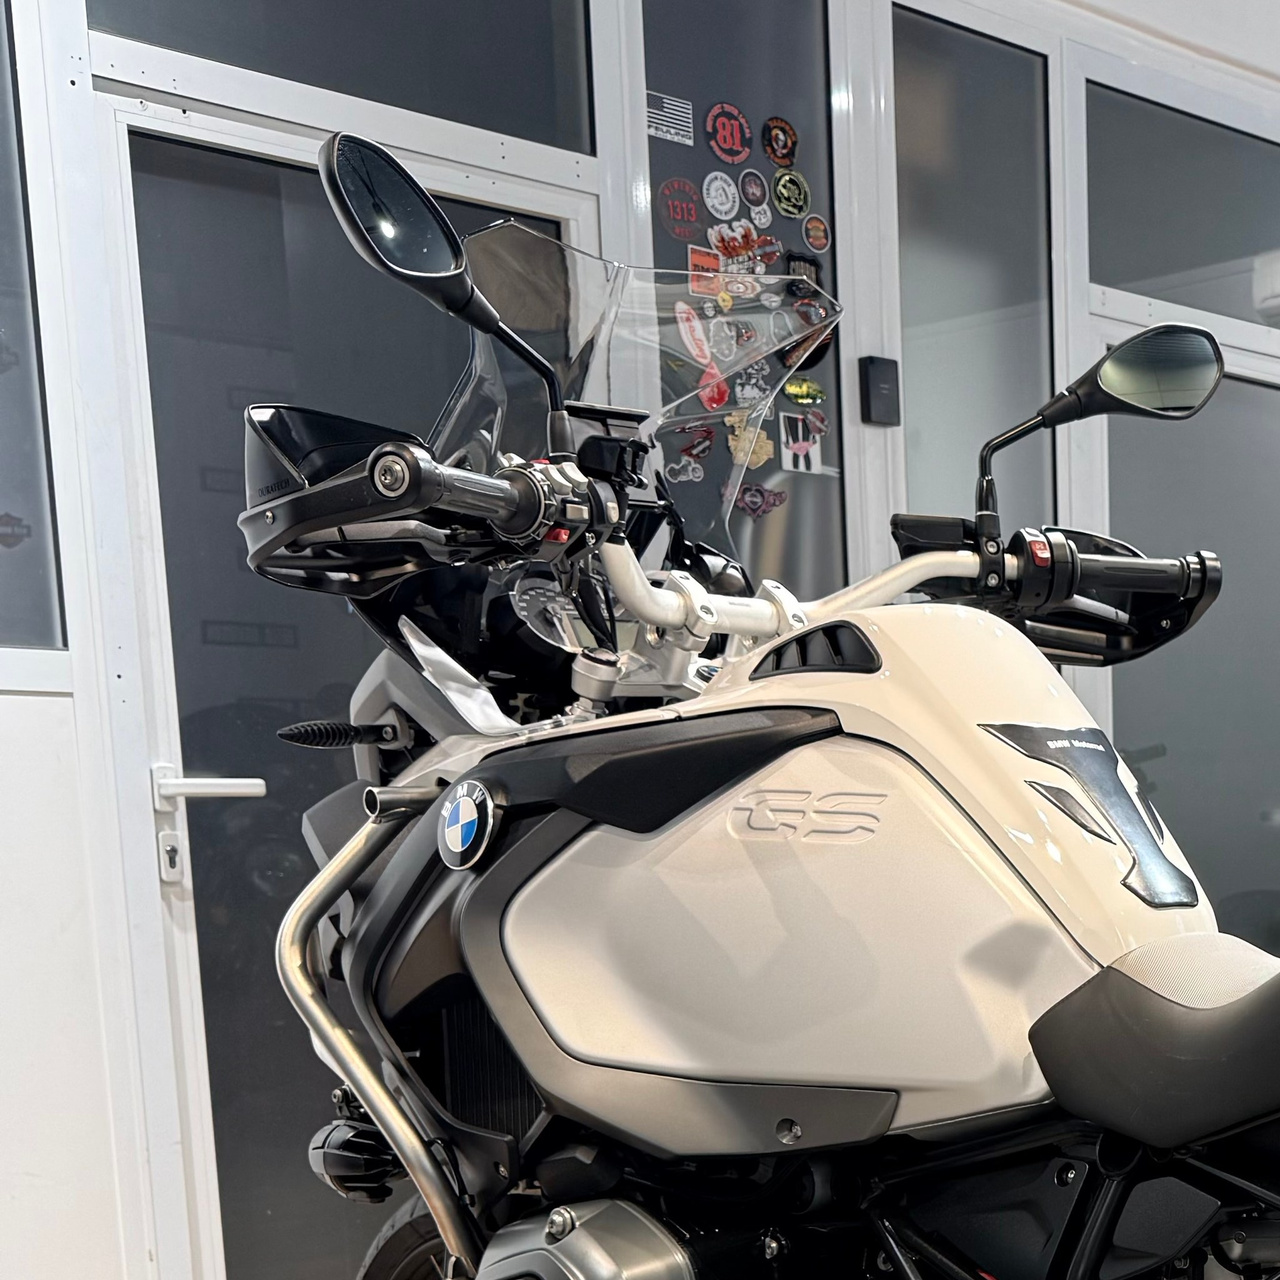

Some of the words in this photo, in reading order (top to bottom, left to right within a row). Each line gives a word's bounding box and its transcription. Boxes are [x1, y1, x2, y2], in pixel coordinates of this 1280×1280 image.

[715, 116, 744, 151] 81
[668, 199, 697, 222] 1313
[440, 784, 486, 818] BMW
[726, 789, 889, 844] GS
